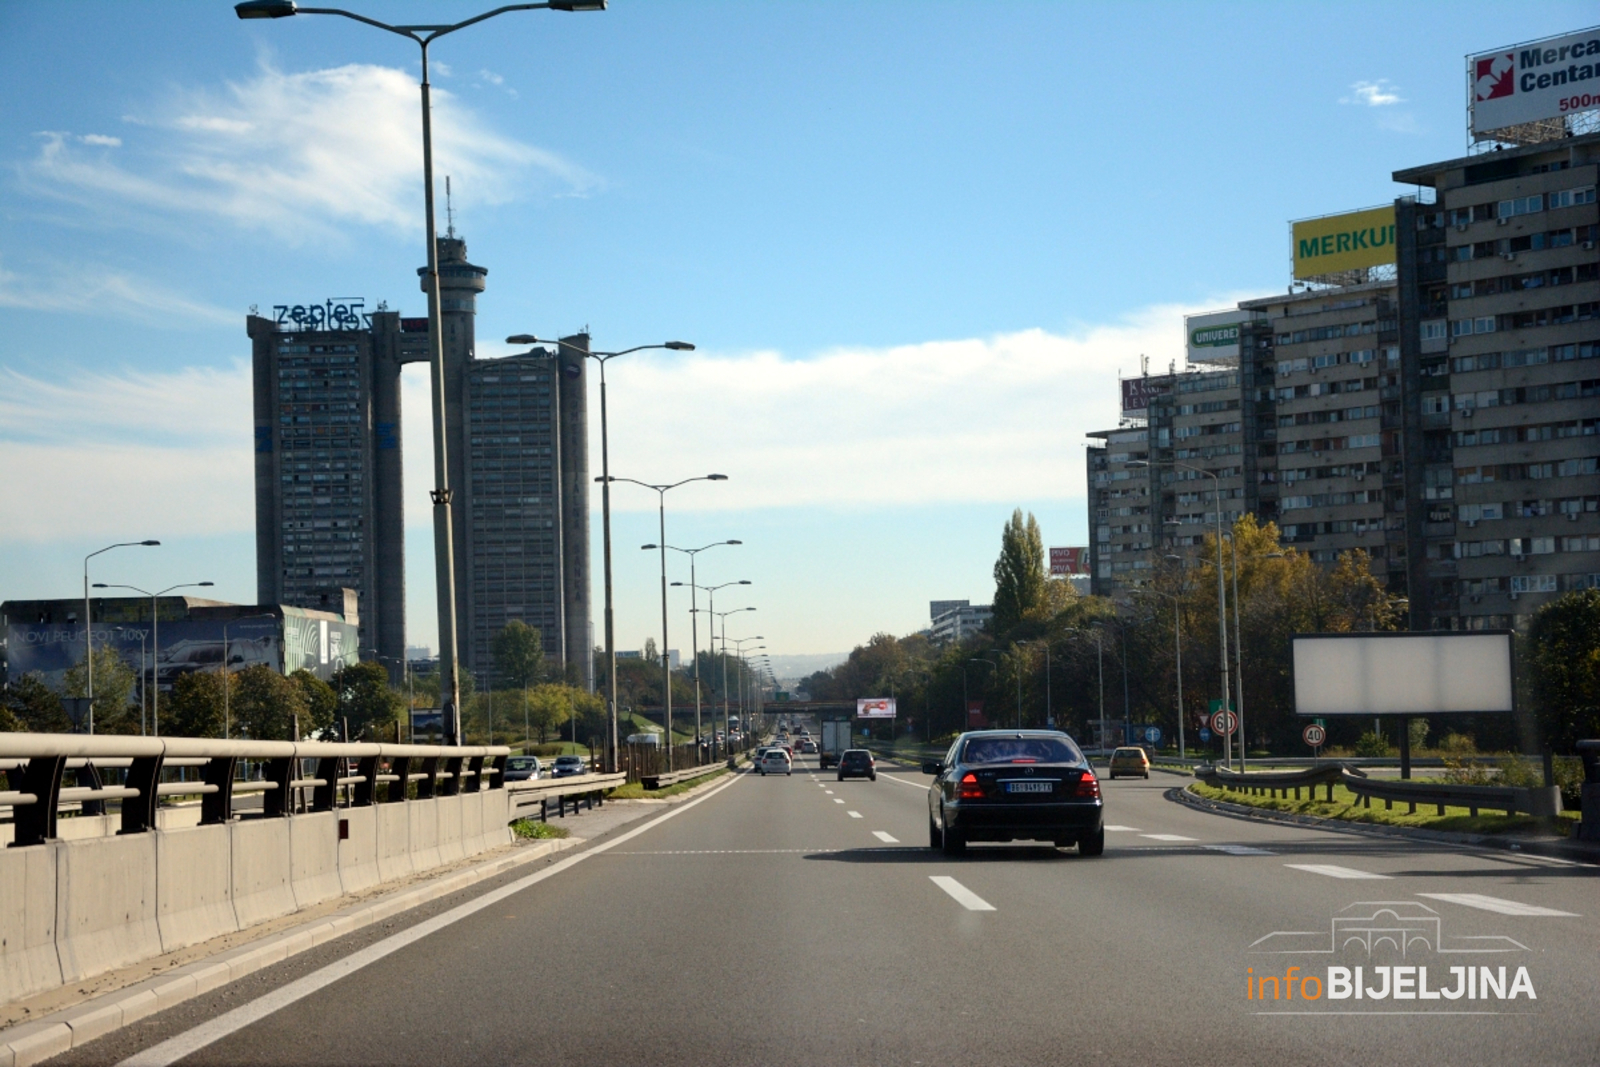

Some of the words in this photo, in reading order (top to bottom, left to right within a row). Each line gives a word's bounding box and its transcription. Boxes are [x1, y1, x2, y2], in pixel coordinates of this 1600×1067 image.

[1520, 39, 1600, 70] Merca
[1051, 549, 1070, 557] PIVO
[1052, 564, 1071, 572] PIVA
[14, 631, 49, 642] NOVI
[53, 630, 115, 642] PEUGEOT
[120, 629, 149, 641] 4007
[1307, 730, 1321, 741] 40
